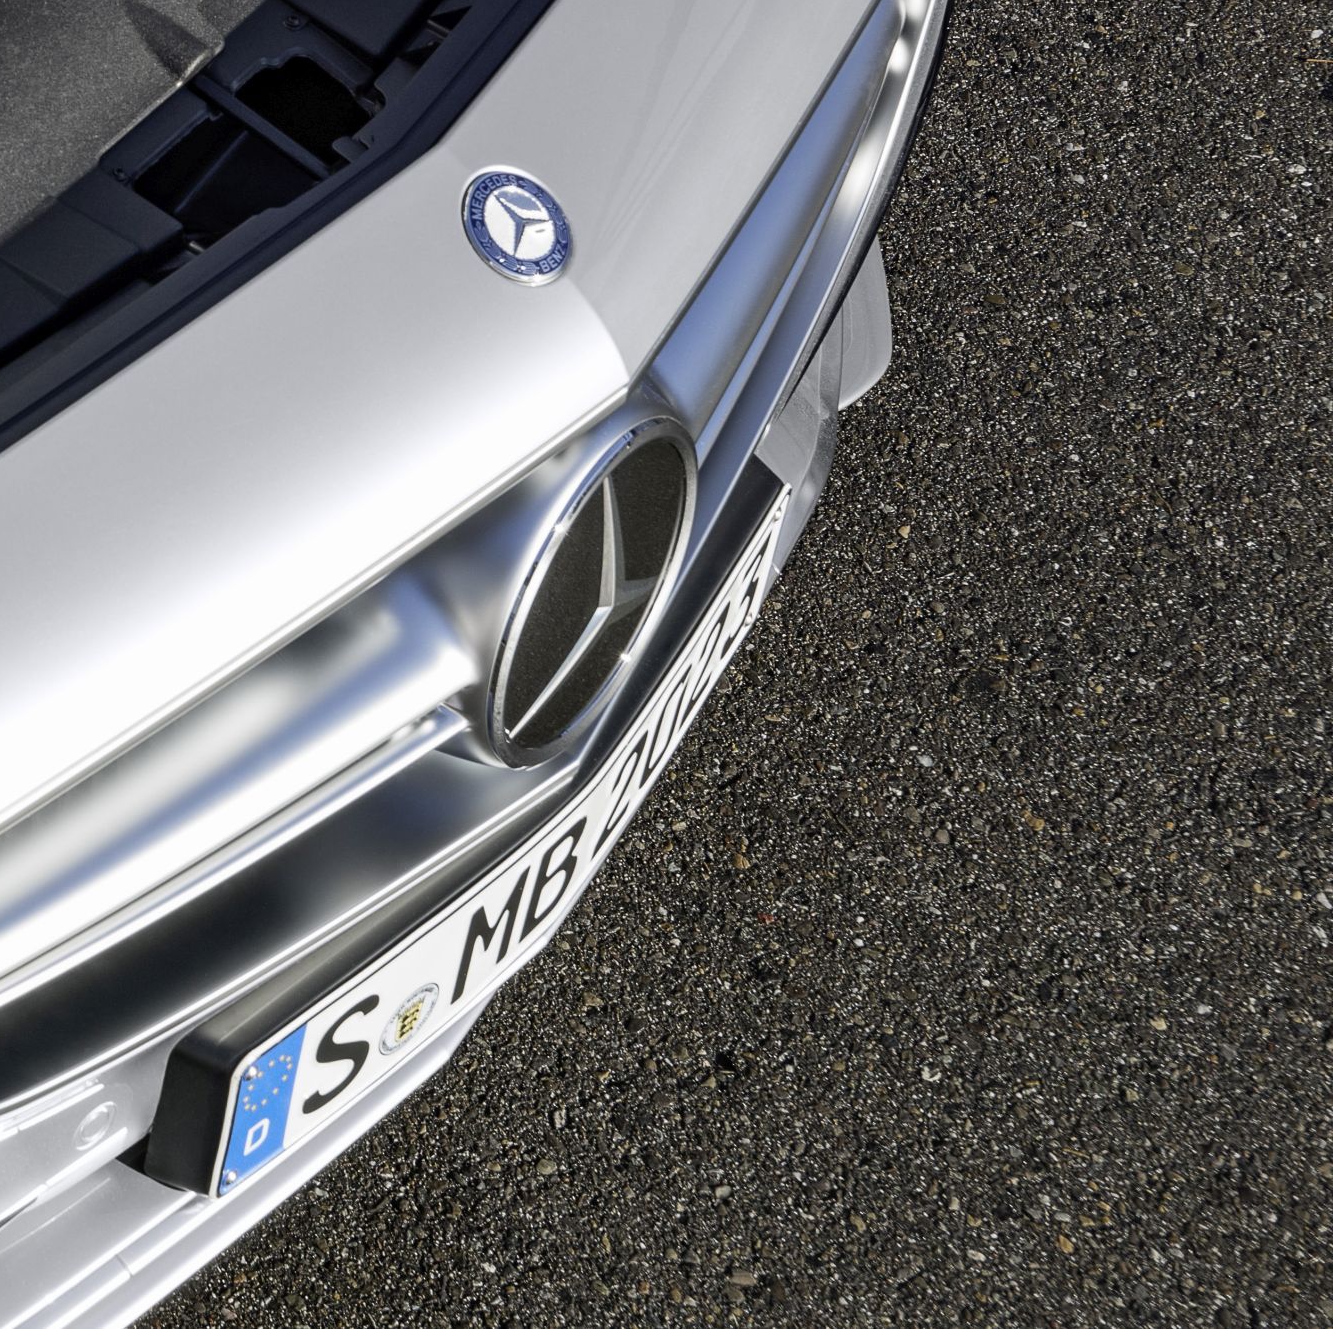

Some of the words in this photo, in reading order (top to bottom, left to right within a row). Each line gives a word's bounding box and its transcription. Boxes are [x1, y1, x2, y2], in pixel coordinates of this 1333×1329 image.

[471, 175, 518, 220] MERCEDES
[539, 243, 566, 273] BENZ
[302, 995, 380, 1115] S
[450, 815, 588, 1005] MB
[590, 530, 773, 861] 2023
[243, 1118, 271, 1156] D
